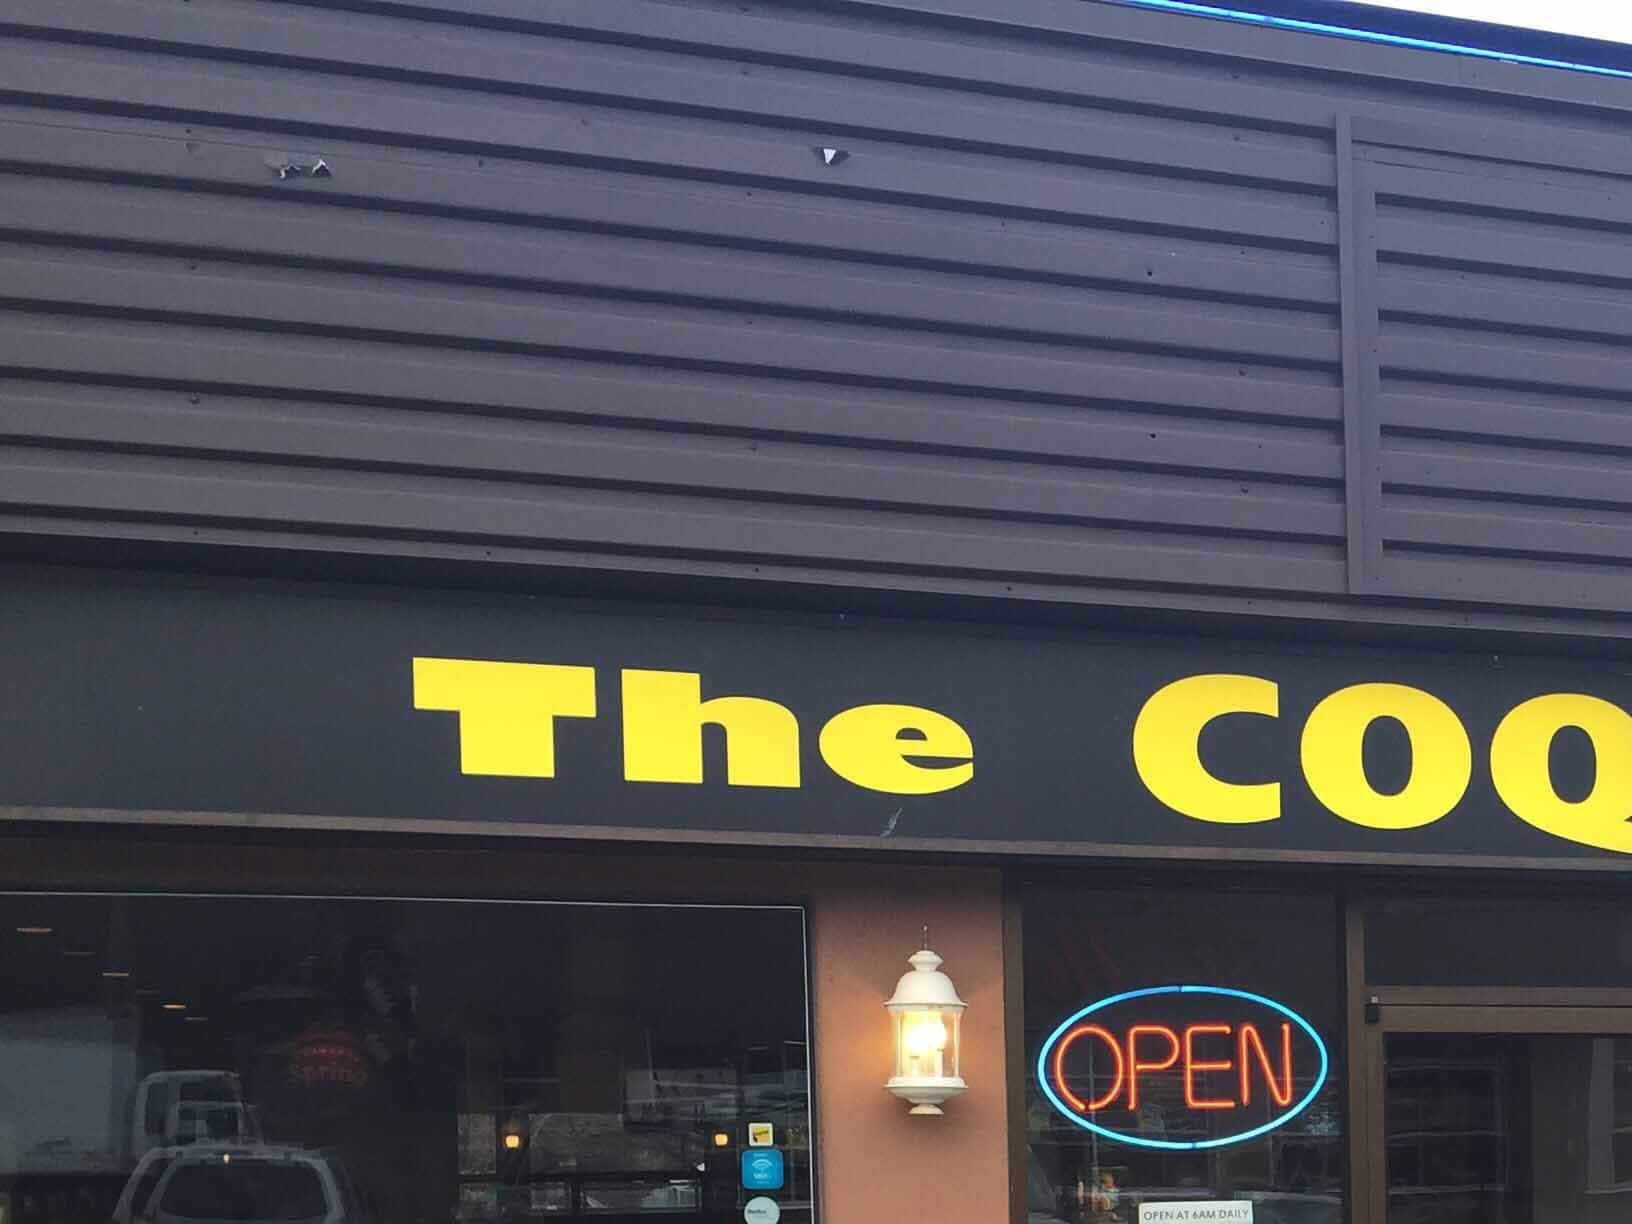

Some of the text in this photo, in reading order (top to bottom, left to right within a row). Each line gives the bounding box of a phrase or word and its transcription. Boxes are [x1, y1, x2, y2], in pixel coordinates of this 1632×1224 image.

[413, 656, 974, 795] The
[1053, 1021, 1293, 1112] OPEN
[1143, 1208, 1249, 1221] OPEN AT 6AM DAILY
